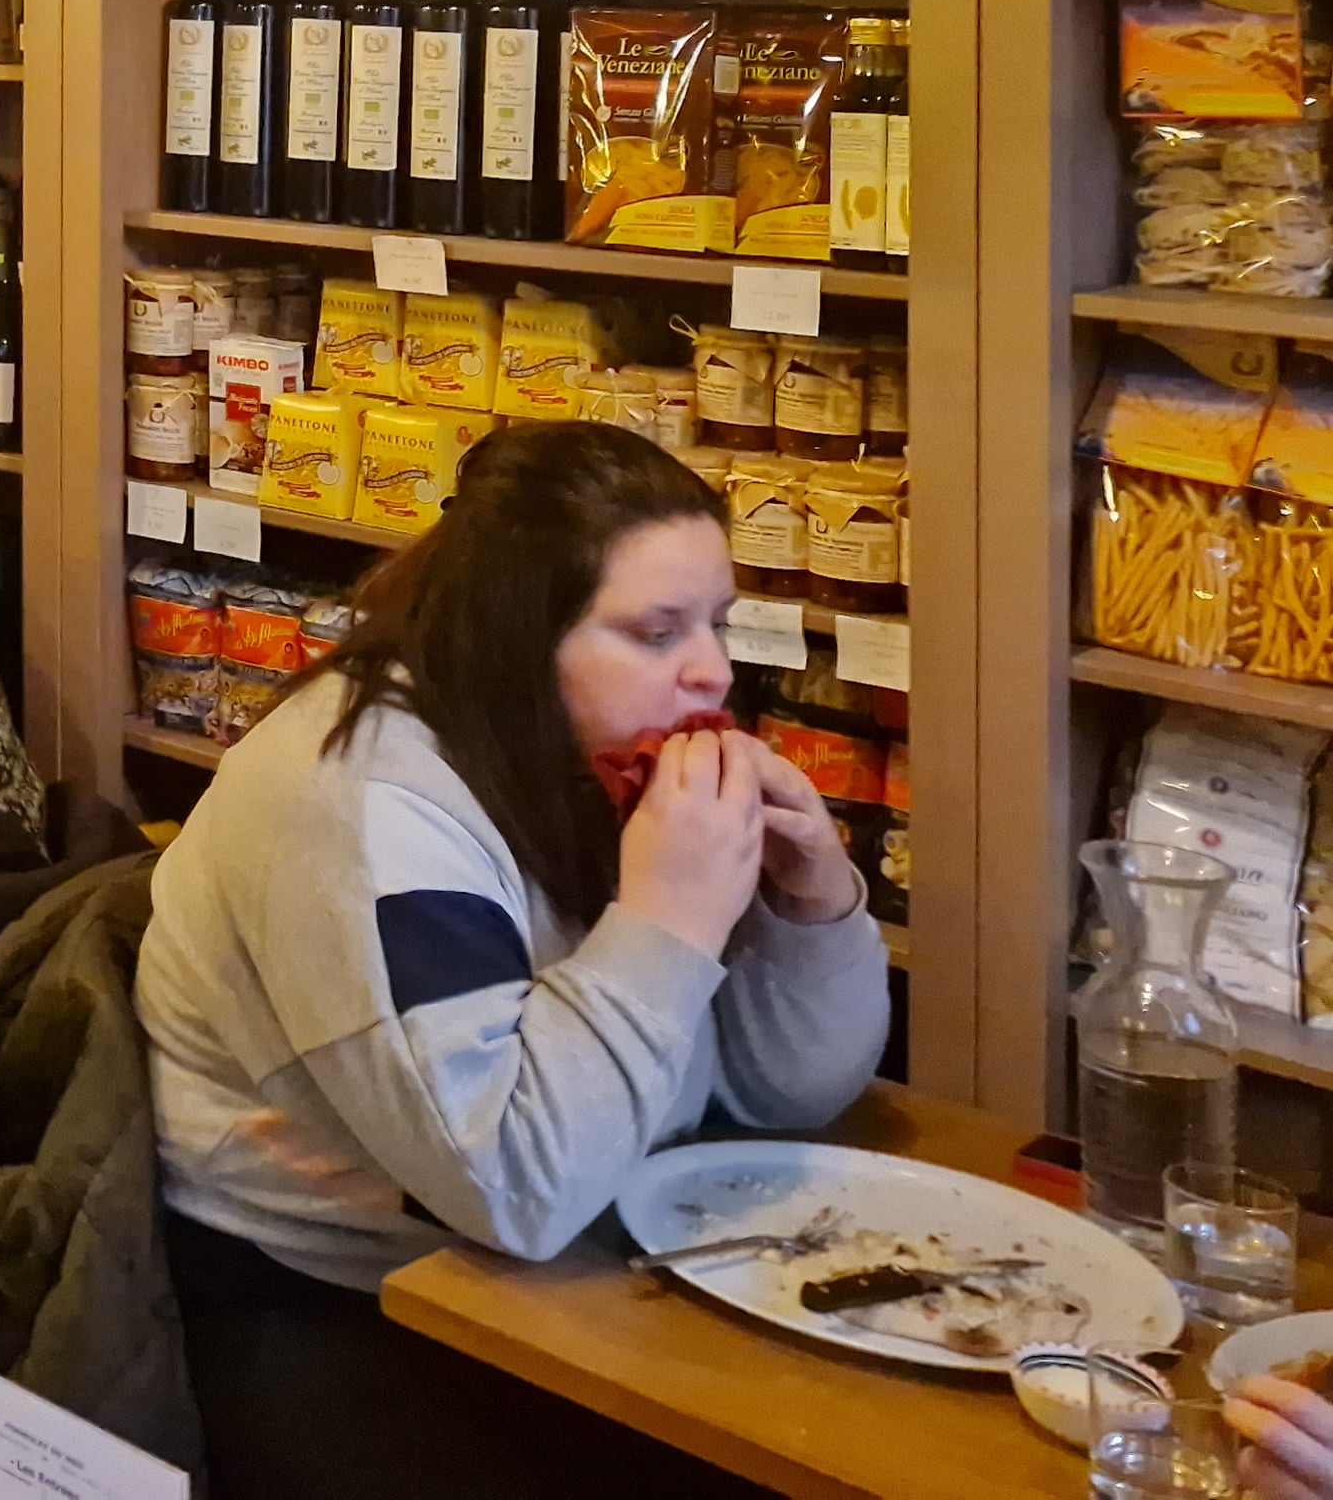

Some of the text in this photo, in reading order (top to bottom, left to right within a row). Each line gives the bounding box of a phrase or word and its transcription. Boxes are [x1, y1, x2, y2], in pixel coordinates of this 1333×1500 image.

[618, 38, 642, 57] Le
[597, 54, 685, 75] Veneziane
[324, 299, 390, 314] PANETTONE
[407, 309, 477, 324] PANETTONE
[216, 354, 270, 371] KIMBO
[270, 414, 338, 434] PANETTONE
[364, 430, 435, 451] PANETTONE
